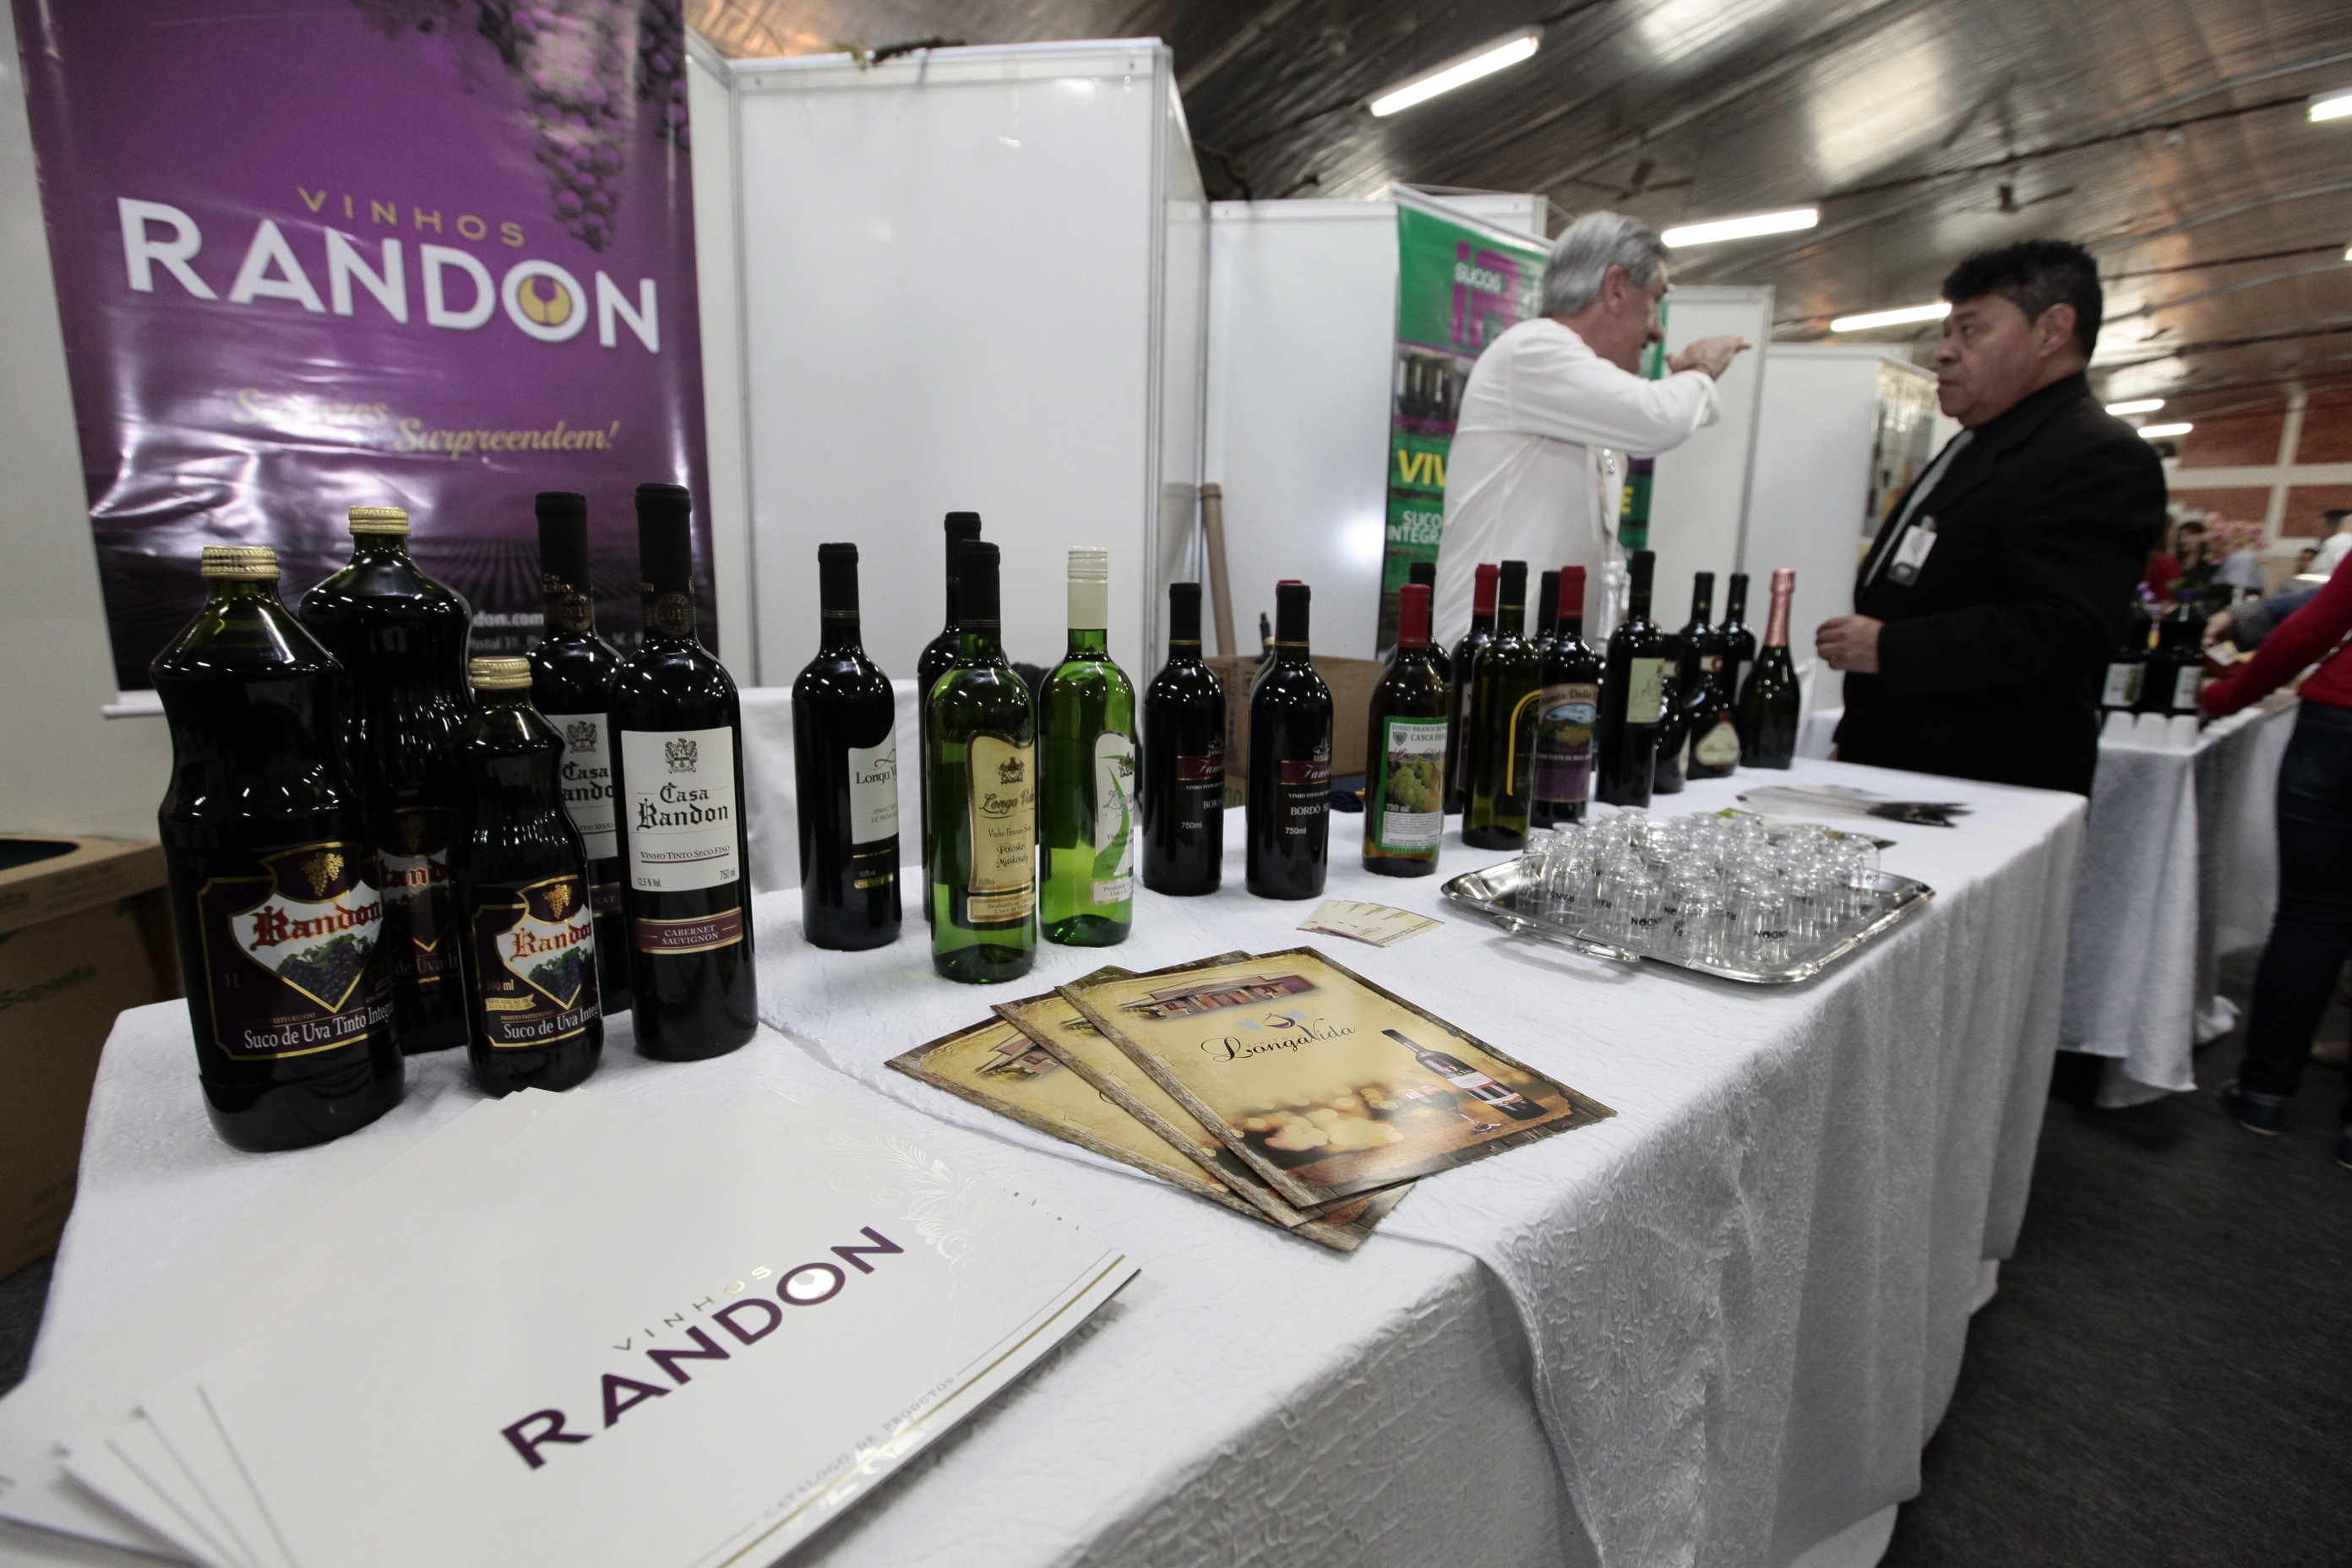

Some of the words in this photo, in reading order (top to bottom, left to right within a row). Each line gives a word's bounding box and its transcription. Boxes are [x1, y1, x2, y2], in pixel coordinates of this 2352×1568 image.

[297, 187, 525, 247] VINHOS
[117, 197, 659, 354] RANDON
[394, 417, 620, 461] Surpreendem!
[563, 760, 608, 781] Casa
[856, 771, 890, 785] Longa
[660, 781, 709, 803] Casa
[979, 792, 1019, 814] Longa
[636, 798, 729, 831] Randon
[1290, 803, 1321, 815] BORDÔ
[988, 827, 1004, 837] Vinho
[640, 850, 666, 860] VINHO
[667, 850, 692, 859] TINTO
[694, 847, 713, 858] SECO
[714, 845, 730, 855] FINO
[249, 901, 382, 952] Randon
[664, 924, 716, 937] CABERNET
[662, 932, 719, 945] SAUVIGNON
[416, 956, 444, 973] Uva
[503, 978, 514, 991] ml
[244, 1030, 279, 1049] Suco
[281, 1026, 299, 1045] de
[302, 1023, 331, 1043] Uva
[333, 1014, 367, 1036] Tinto
[504, 1023, 535, 1039] Suco
[538, 1020, 554, 1035] de
[557, 1015, 578, 1031] Uva
[612, 1266, 773, 1352] VINHOS
[500, 1226, 905, 1470] RANDON
[884, 1375, 957, 1434] PRODUTOS
